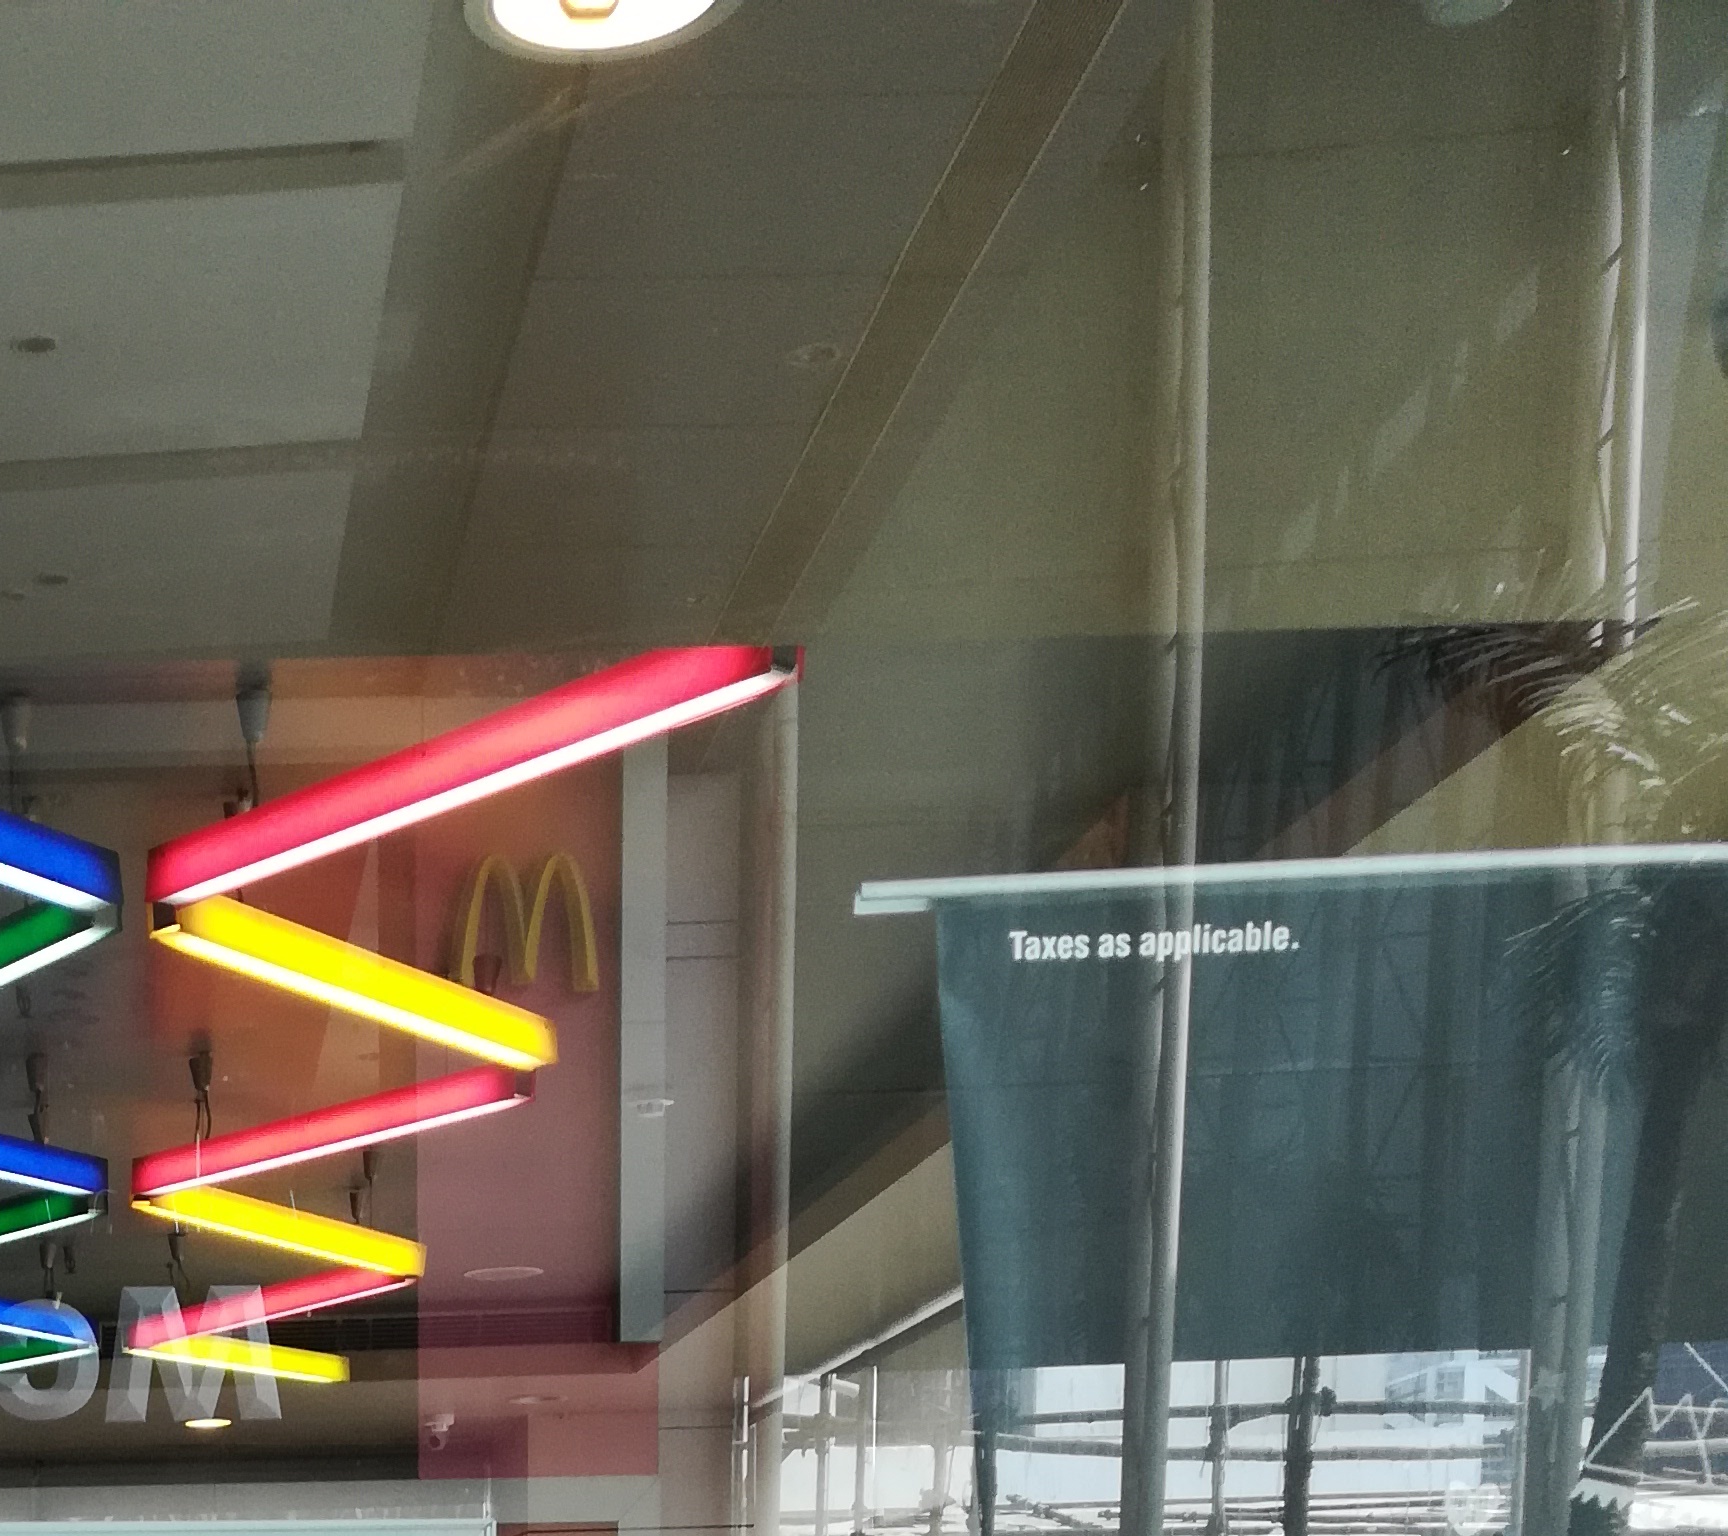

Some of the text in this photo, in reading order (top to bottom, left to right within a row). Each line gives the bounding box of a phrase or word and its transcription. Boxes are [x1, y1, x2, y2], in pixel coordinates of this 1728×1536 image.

[1010, 920, 1300, 962] Taxes as applicable.
